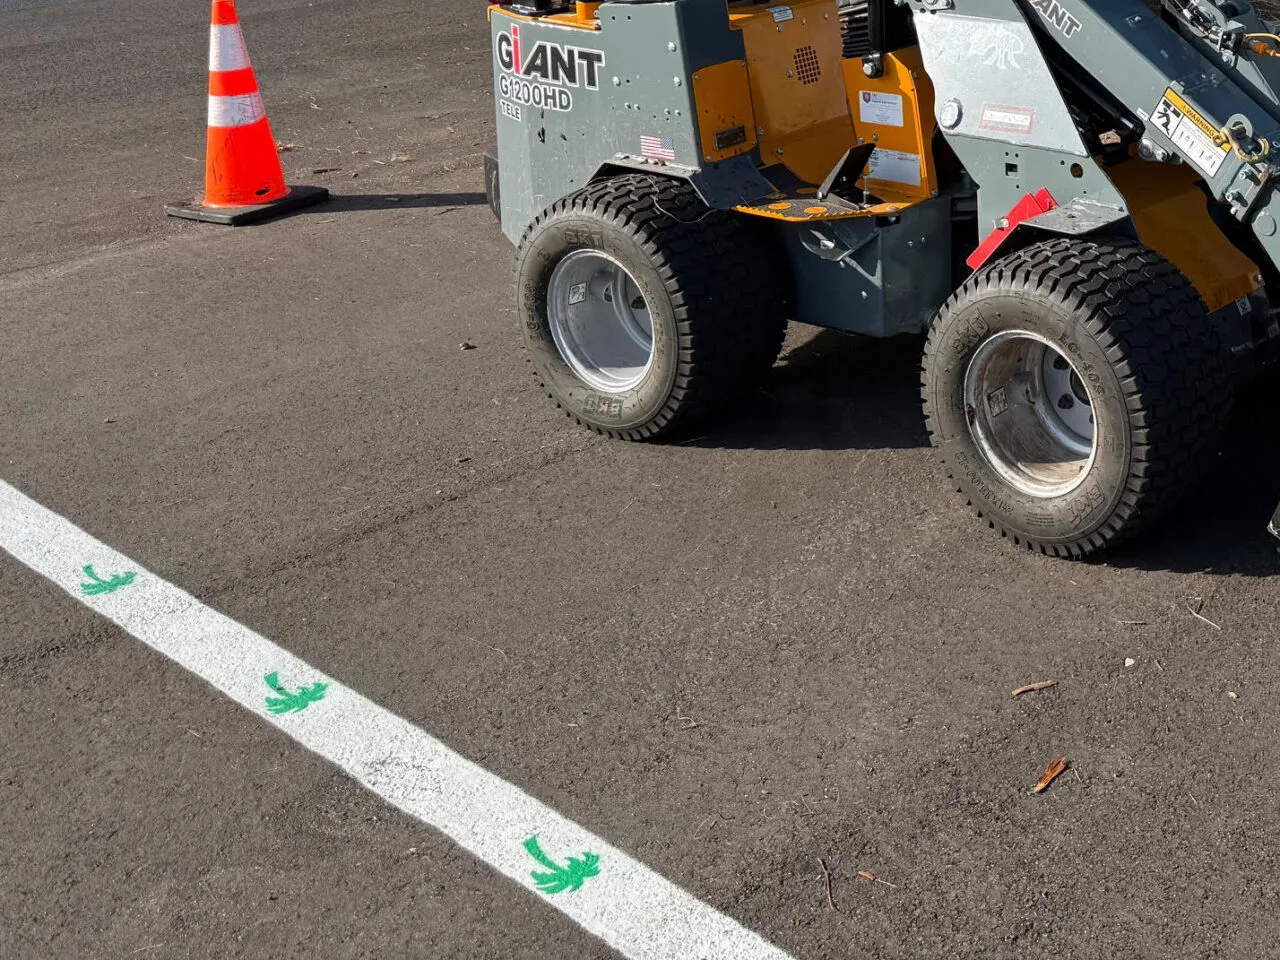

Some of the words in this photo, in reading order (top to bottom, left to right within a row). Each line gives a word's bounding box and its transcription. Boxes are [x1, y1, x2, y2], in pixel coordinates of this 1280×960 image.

[500, 74, 572, 112] G1200HD
[501, 100, 521, 121] TELE
[1186, 109, 1215, 136] WARNING
